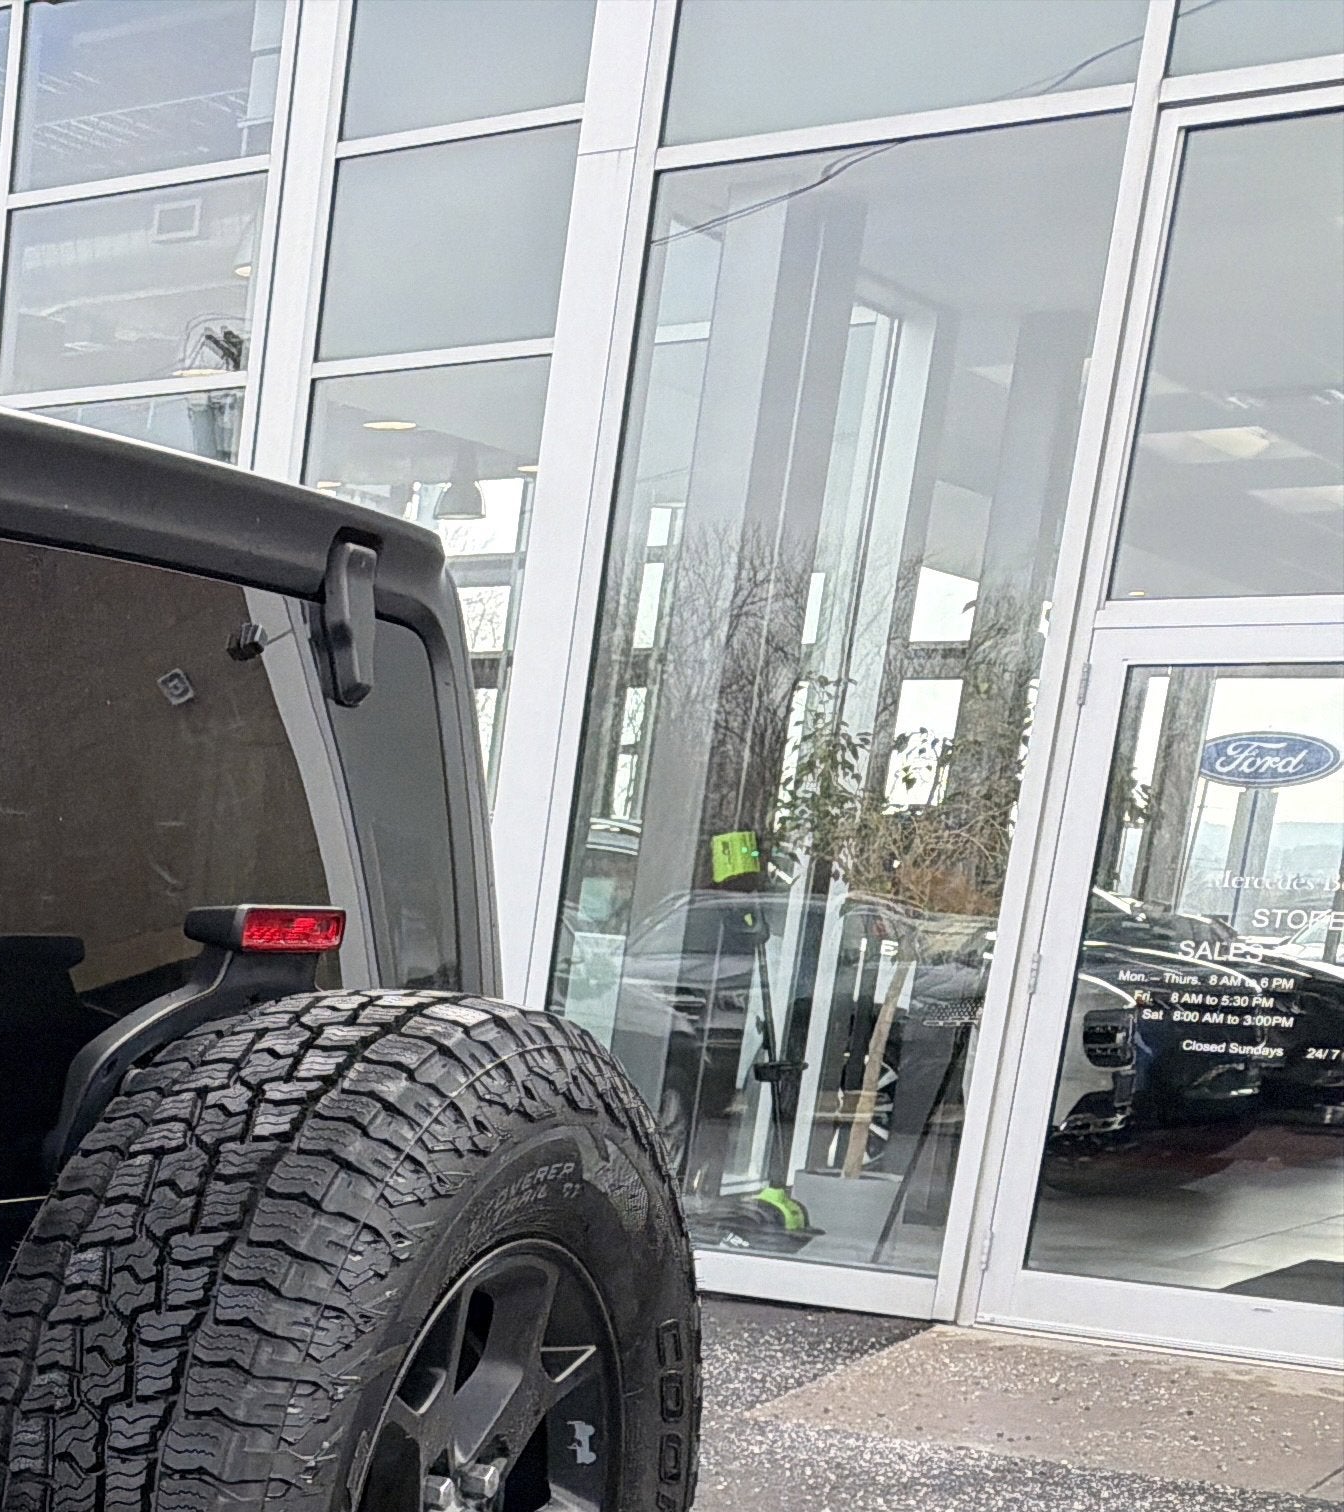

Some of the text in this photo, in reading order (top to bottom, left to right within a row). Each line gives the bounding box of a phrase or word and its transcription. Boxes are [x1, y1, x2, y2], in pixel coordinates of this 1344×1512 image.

[1215, 740, 1308, 773] Ford
[1251, 908, 1344, 931] STORE
[1178, 940, 1264, 962] SALES
[1118, 970, 1148, 982] Mon.
[1163, 972, 1202, 985] Thurs.
[1209, 974, 1218, 986] 8
[1219, 975, 1242, 987] AM
[1260, 977, 1269, 989] 6
[1272, 977, 1295, 990] PM
[1171, 991, 1180, 1004] 8
[1180, 992, 1204, 1005] AM
[1205, 994, 1219, 1006] to
[1221, 995, 1249, 1007] 5:30
[1252, 996, 1275, 1009] PM
[1141, 1008, 1164, 1020] Sat
[1172, 1010, 1200, 1022] 8:00
[1202, 1012, 1225, 1024] AM
[1227, 1014, 1240, 1025] to
[1182, 1039, 1226, 1053] Closed
[1229, 1043, 1285, 1058] Sundays
